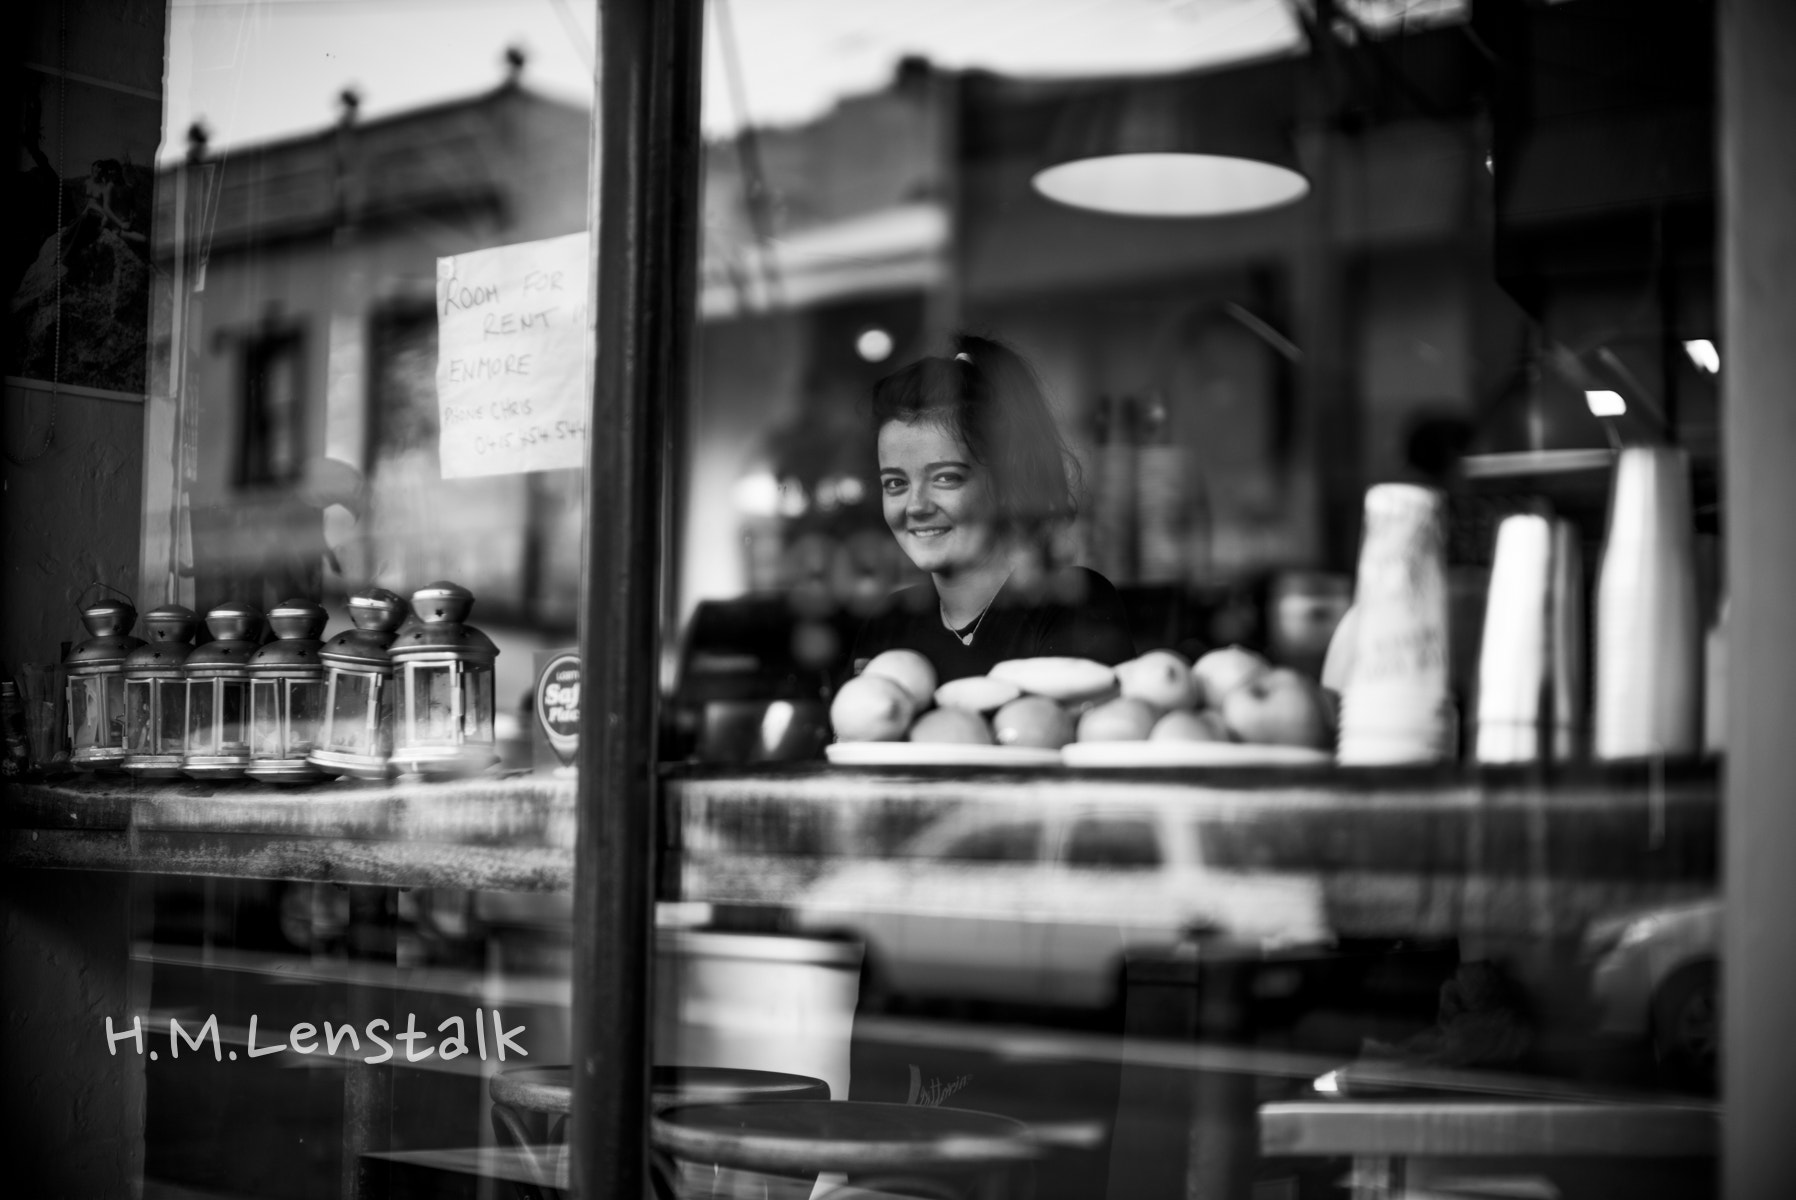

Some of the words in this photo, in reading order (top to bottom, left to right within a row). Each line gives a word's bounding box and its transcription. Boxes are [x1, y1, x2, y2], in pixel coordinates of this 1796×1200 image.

[446, 275, 498, 315] ROOM
[523, 269, 563, 296] FOR
[484, 305, 560, 340] RENT
[449, 353, 532, 382] ENMORE
